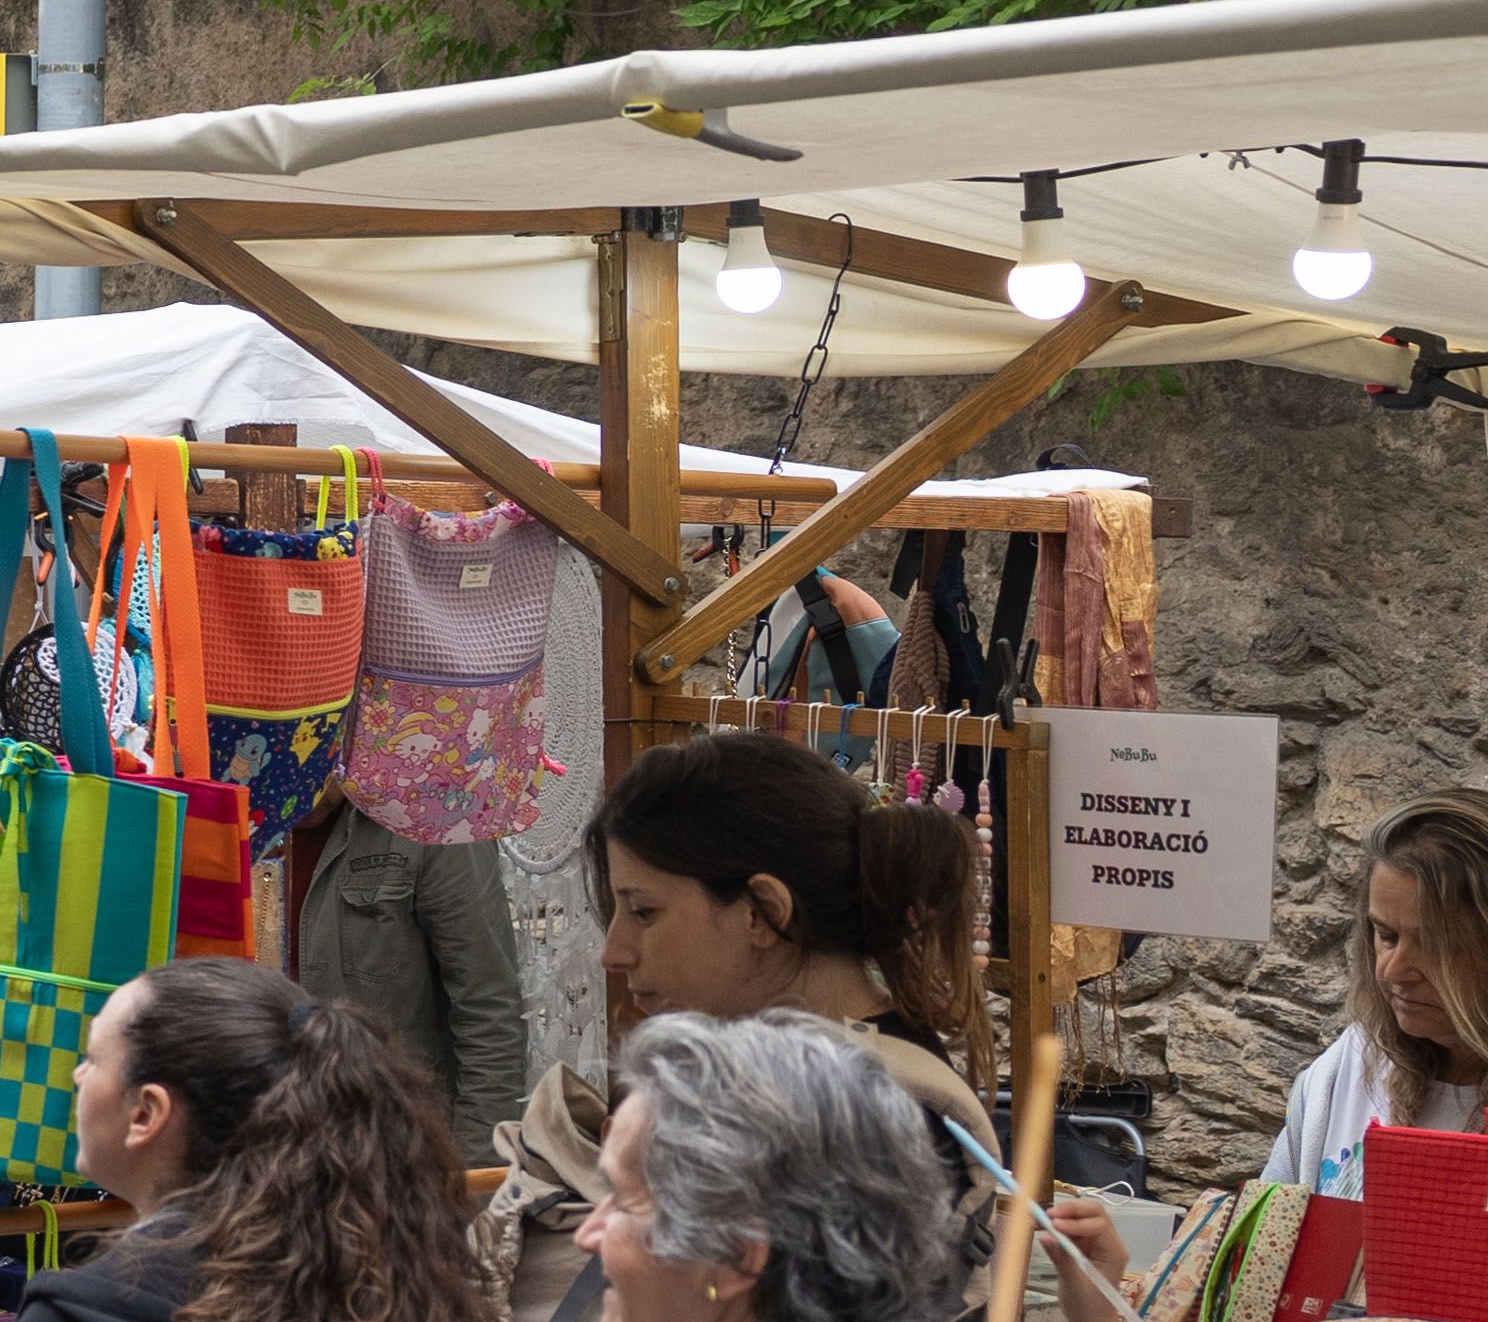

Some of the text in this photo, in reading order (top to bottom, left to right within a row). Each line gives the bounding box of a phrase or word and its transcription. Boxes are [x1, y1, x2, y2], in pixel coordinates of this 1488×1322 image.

[1110, 747, 1157, 762] NeBuBu
[1081, 792, 1191, 818] DISSENY I
[1064, 825, 1209, 854] ELABORACIÓ
[1092, 864, 1175, 890] PROPIS
